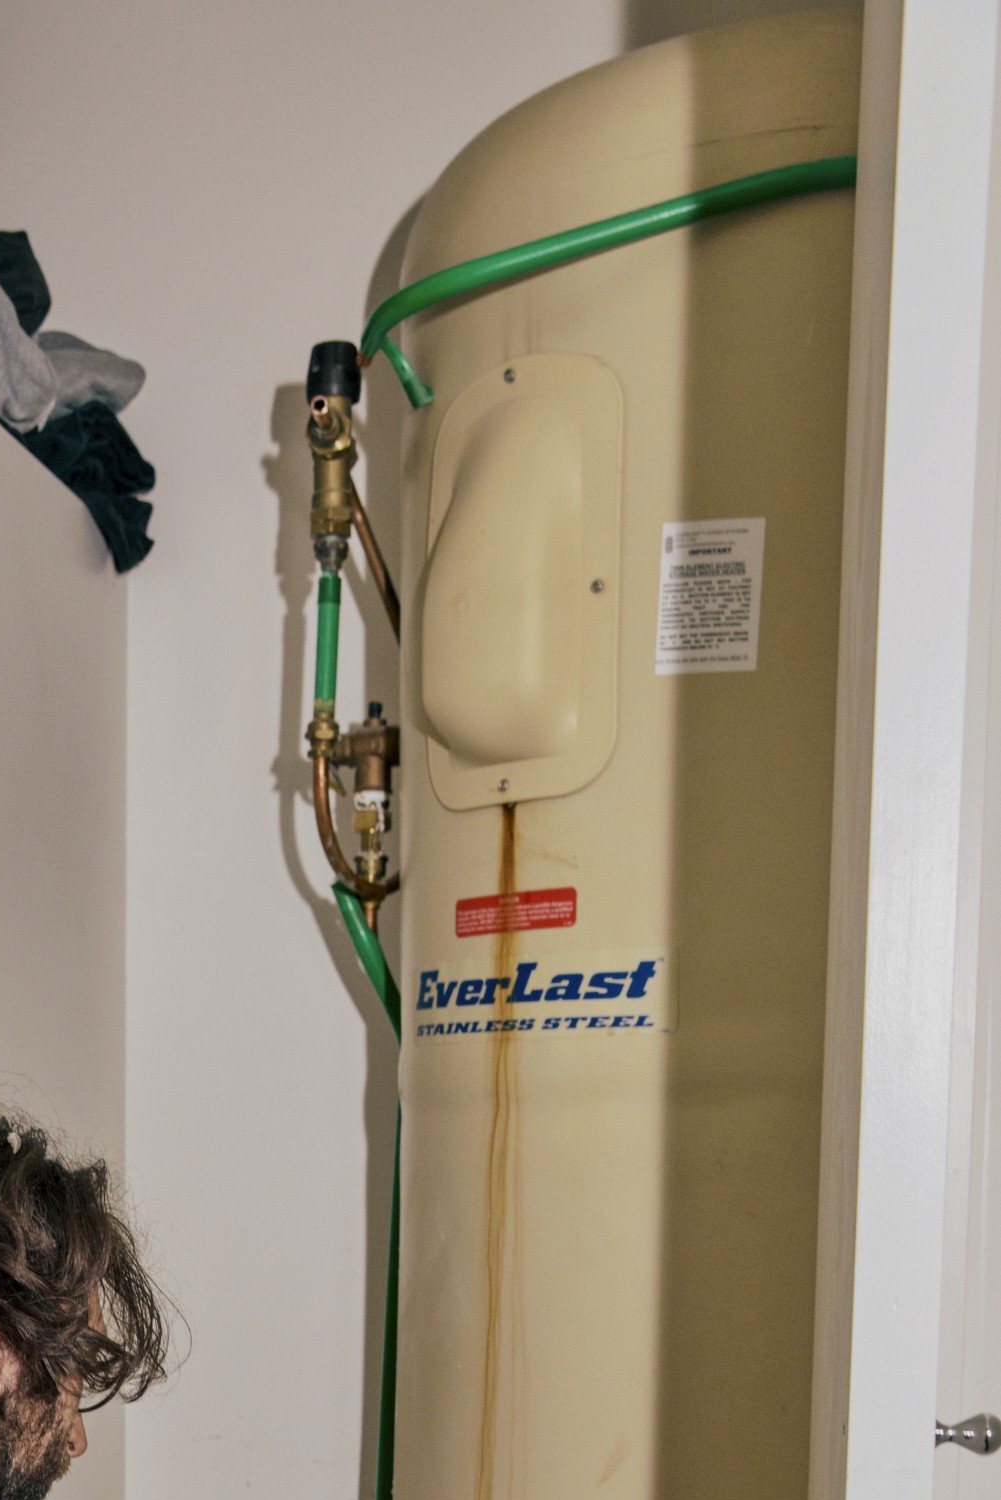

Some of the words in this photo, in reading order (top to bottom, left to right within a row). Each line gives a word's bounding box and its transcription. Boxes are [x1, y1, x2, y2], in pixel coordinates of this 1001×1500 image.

[688, 547, 732, 557] IMPORTANT
[416, 960, 656, 1011] EverLast
[417, 1017, 535, 1037] STAINLESS
[541, 1014, 654, 1031] STEEL
